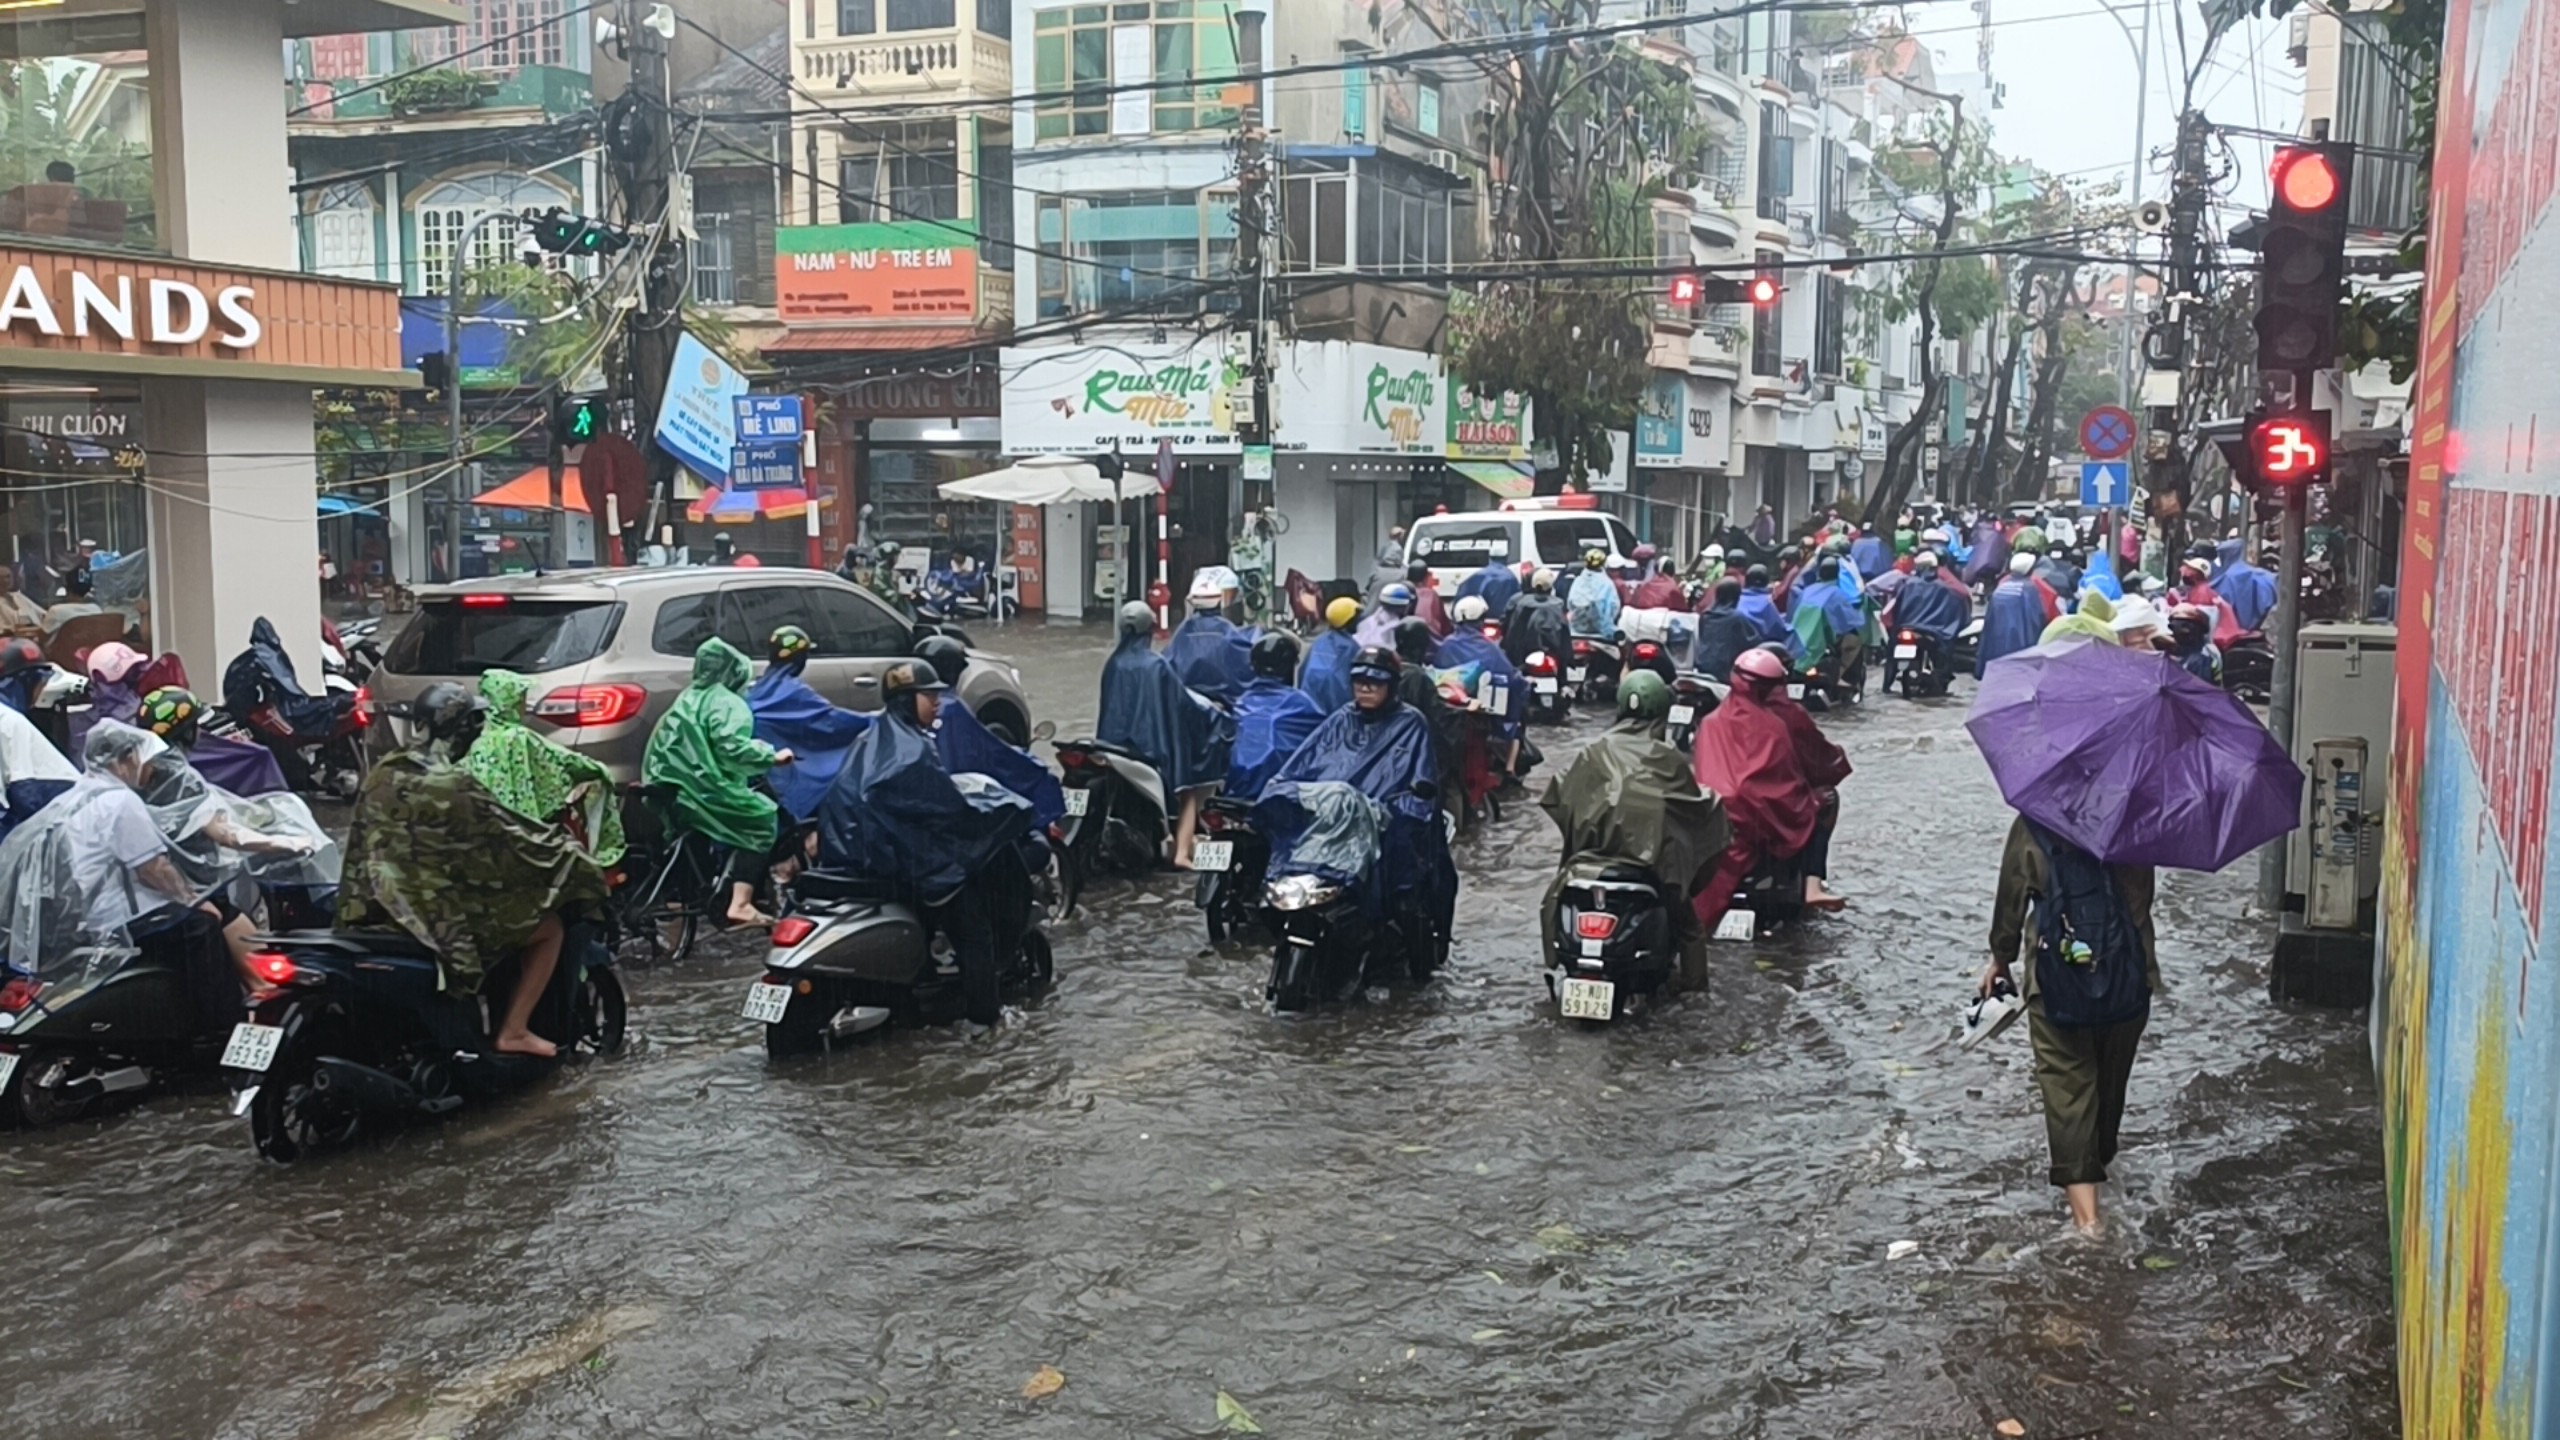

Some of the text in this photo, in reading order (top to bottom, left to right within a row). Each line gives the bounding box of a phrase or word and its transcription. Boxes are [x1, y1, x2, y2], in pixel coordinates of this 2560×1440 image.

[794, 252, 836, 271] NAM
[0, 264, 262, 348] ANDS
[2268, 427, 2316, 471] 34
